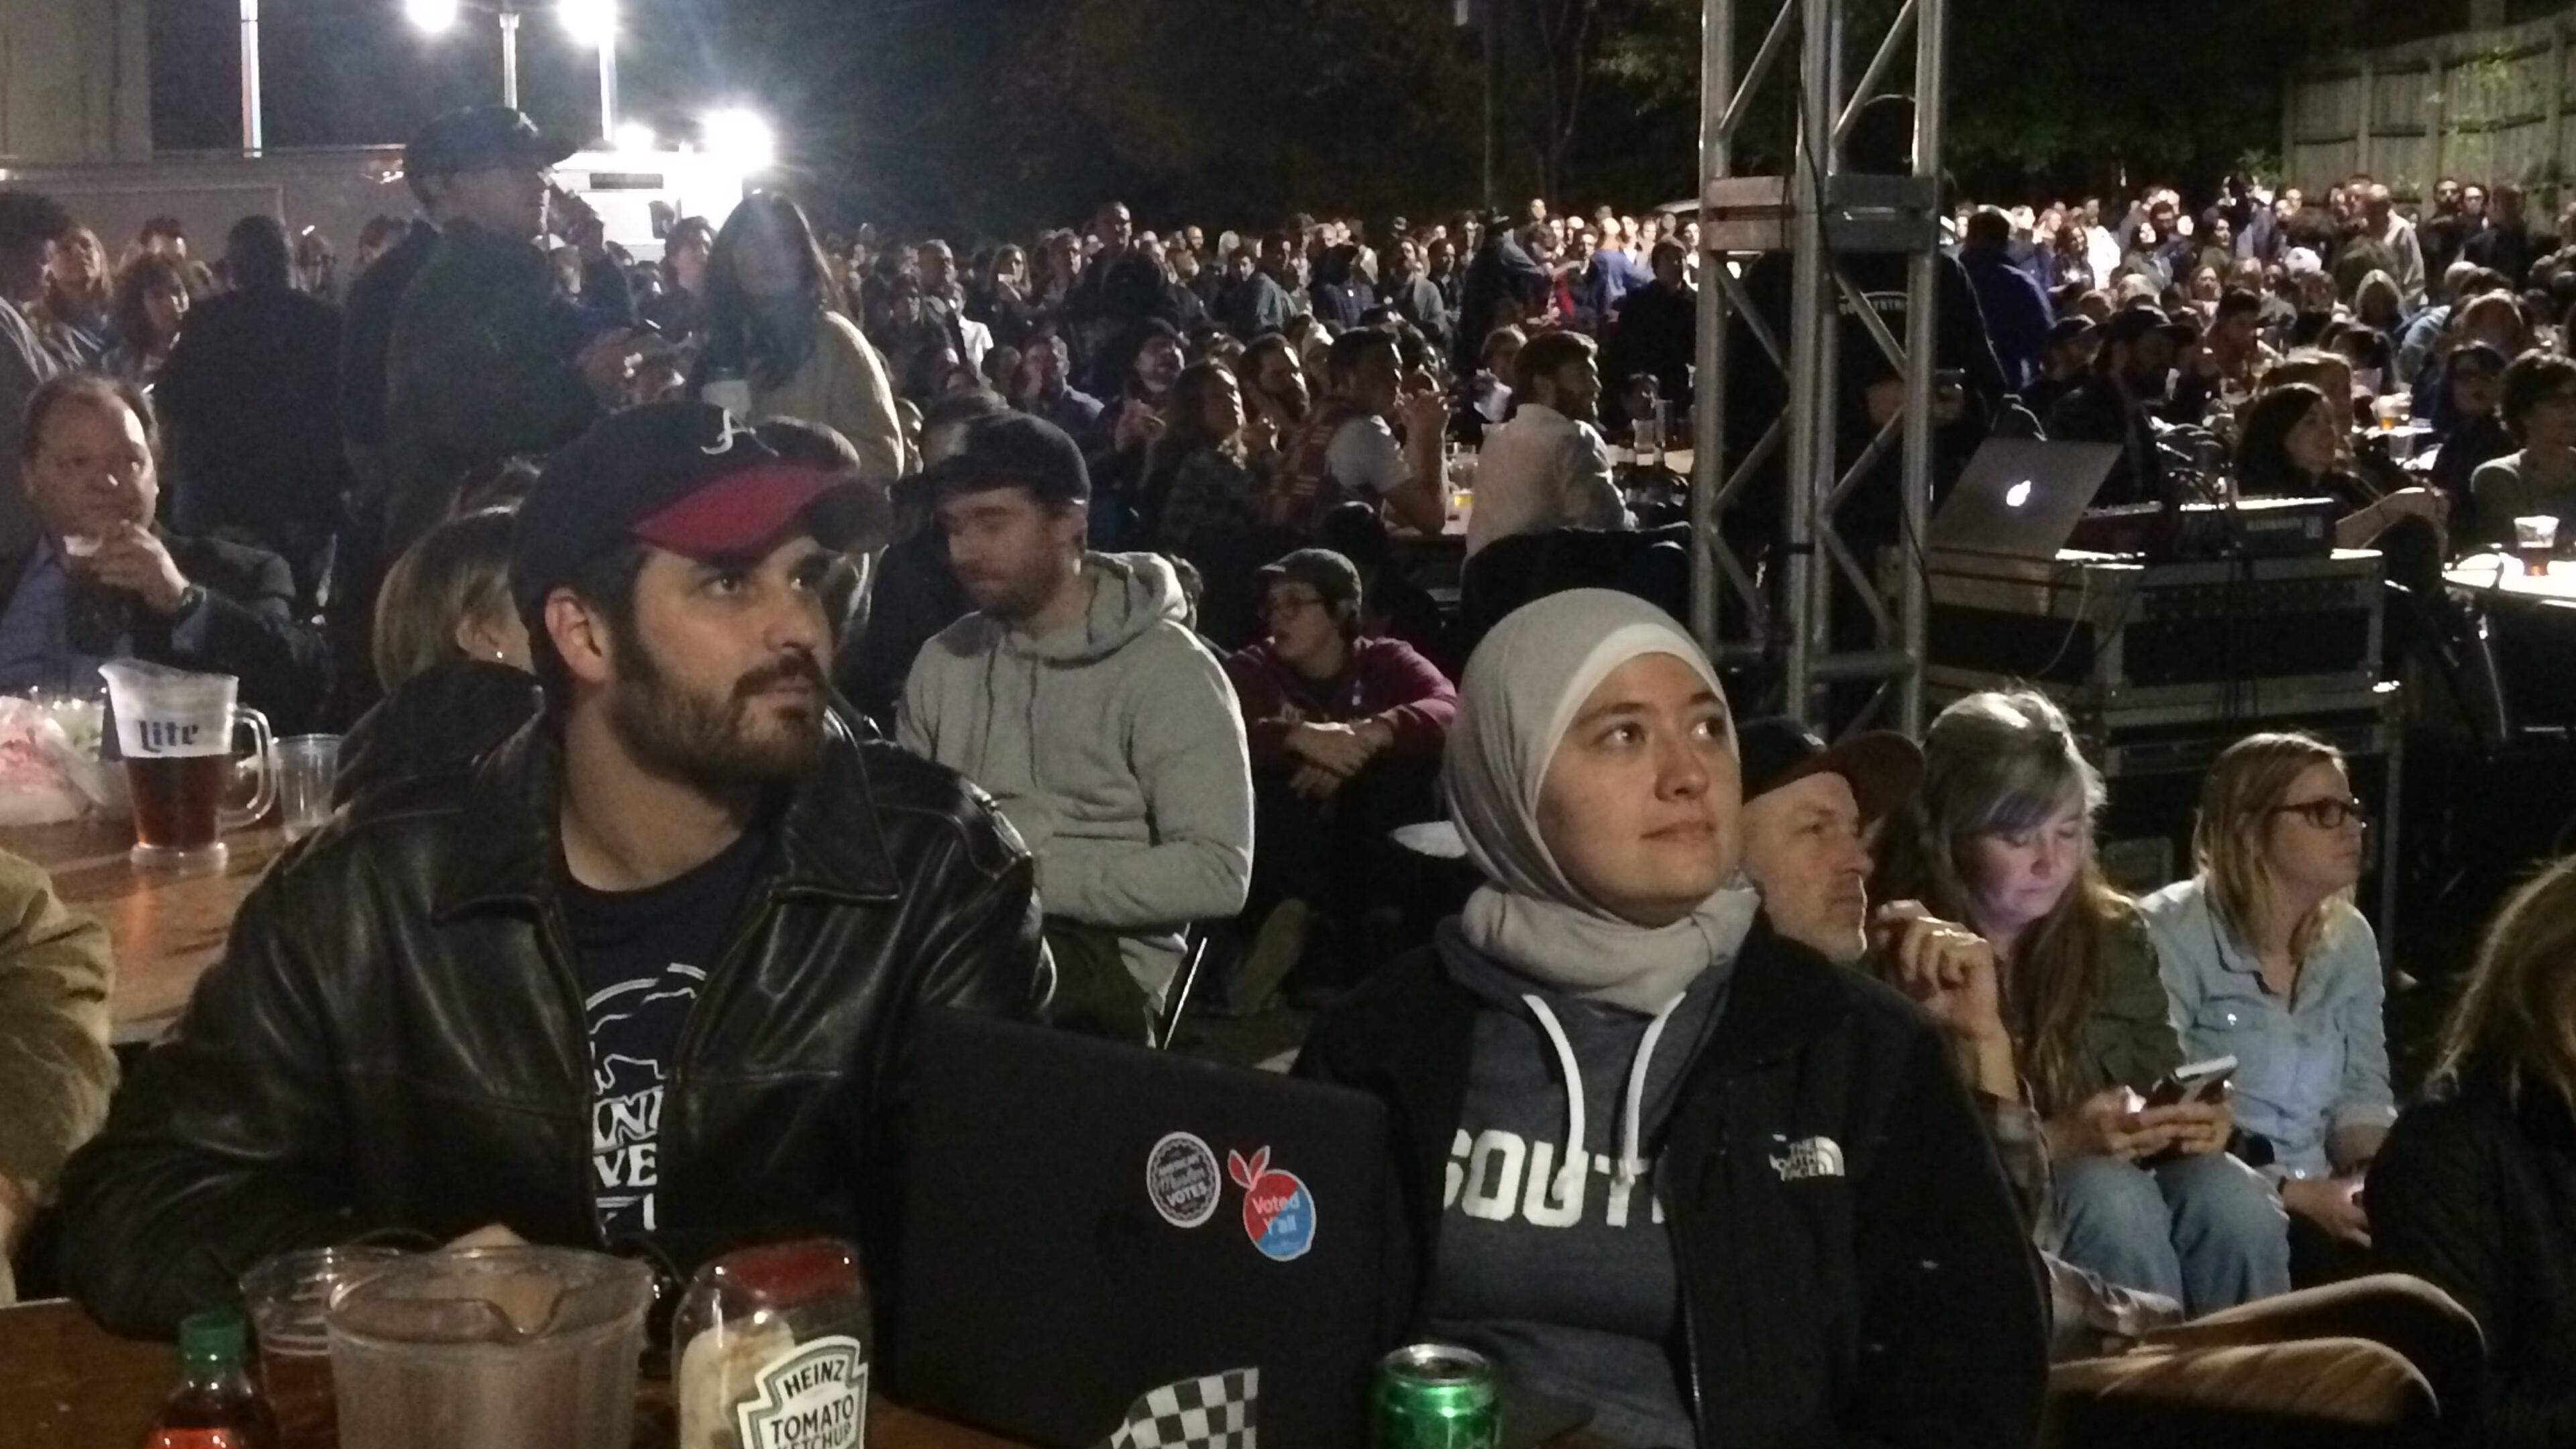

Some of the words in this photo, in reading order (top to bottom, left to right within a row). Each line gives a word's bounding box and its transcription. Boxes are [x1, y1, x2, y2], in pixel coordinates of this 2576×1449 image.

[138, 720, 199, 753] Lite
[1166, 1181, 1207, 1207] VOTES
[1443, 1128, 1666, 1228] OUT
[1251, 1191, 1301, 1216] Voted
[783, 1359, 845, 1399] HEINZ
[770, 1393, 855, 1444] TOMATO
[776, 1420, 852, 1449] CHUP
